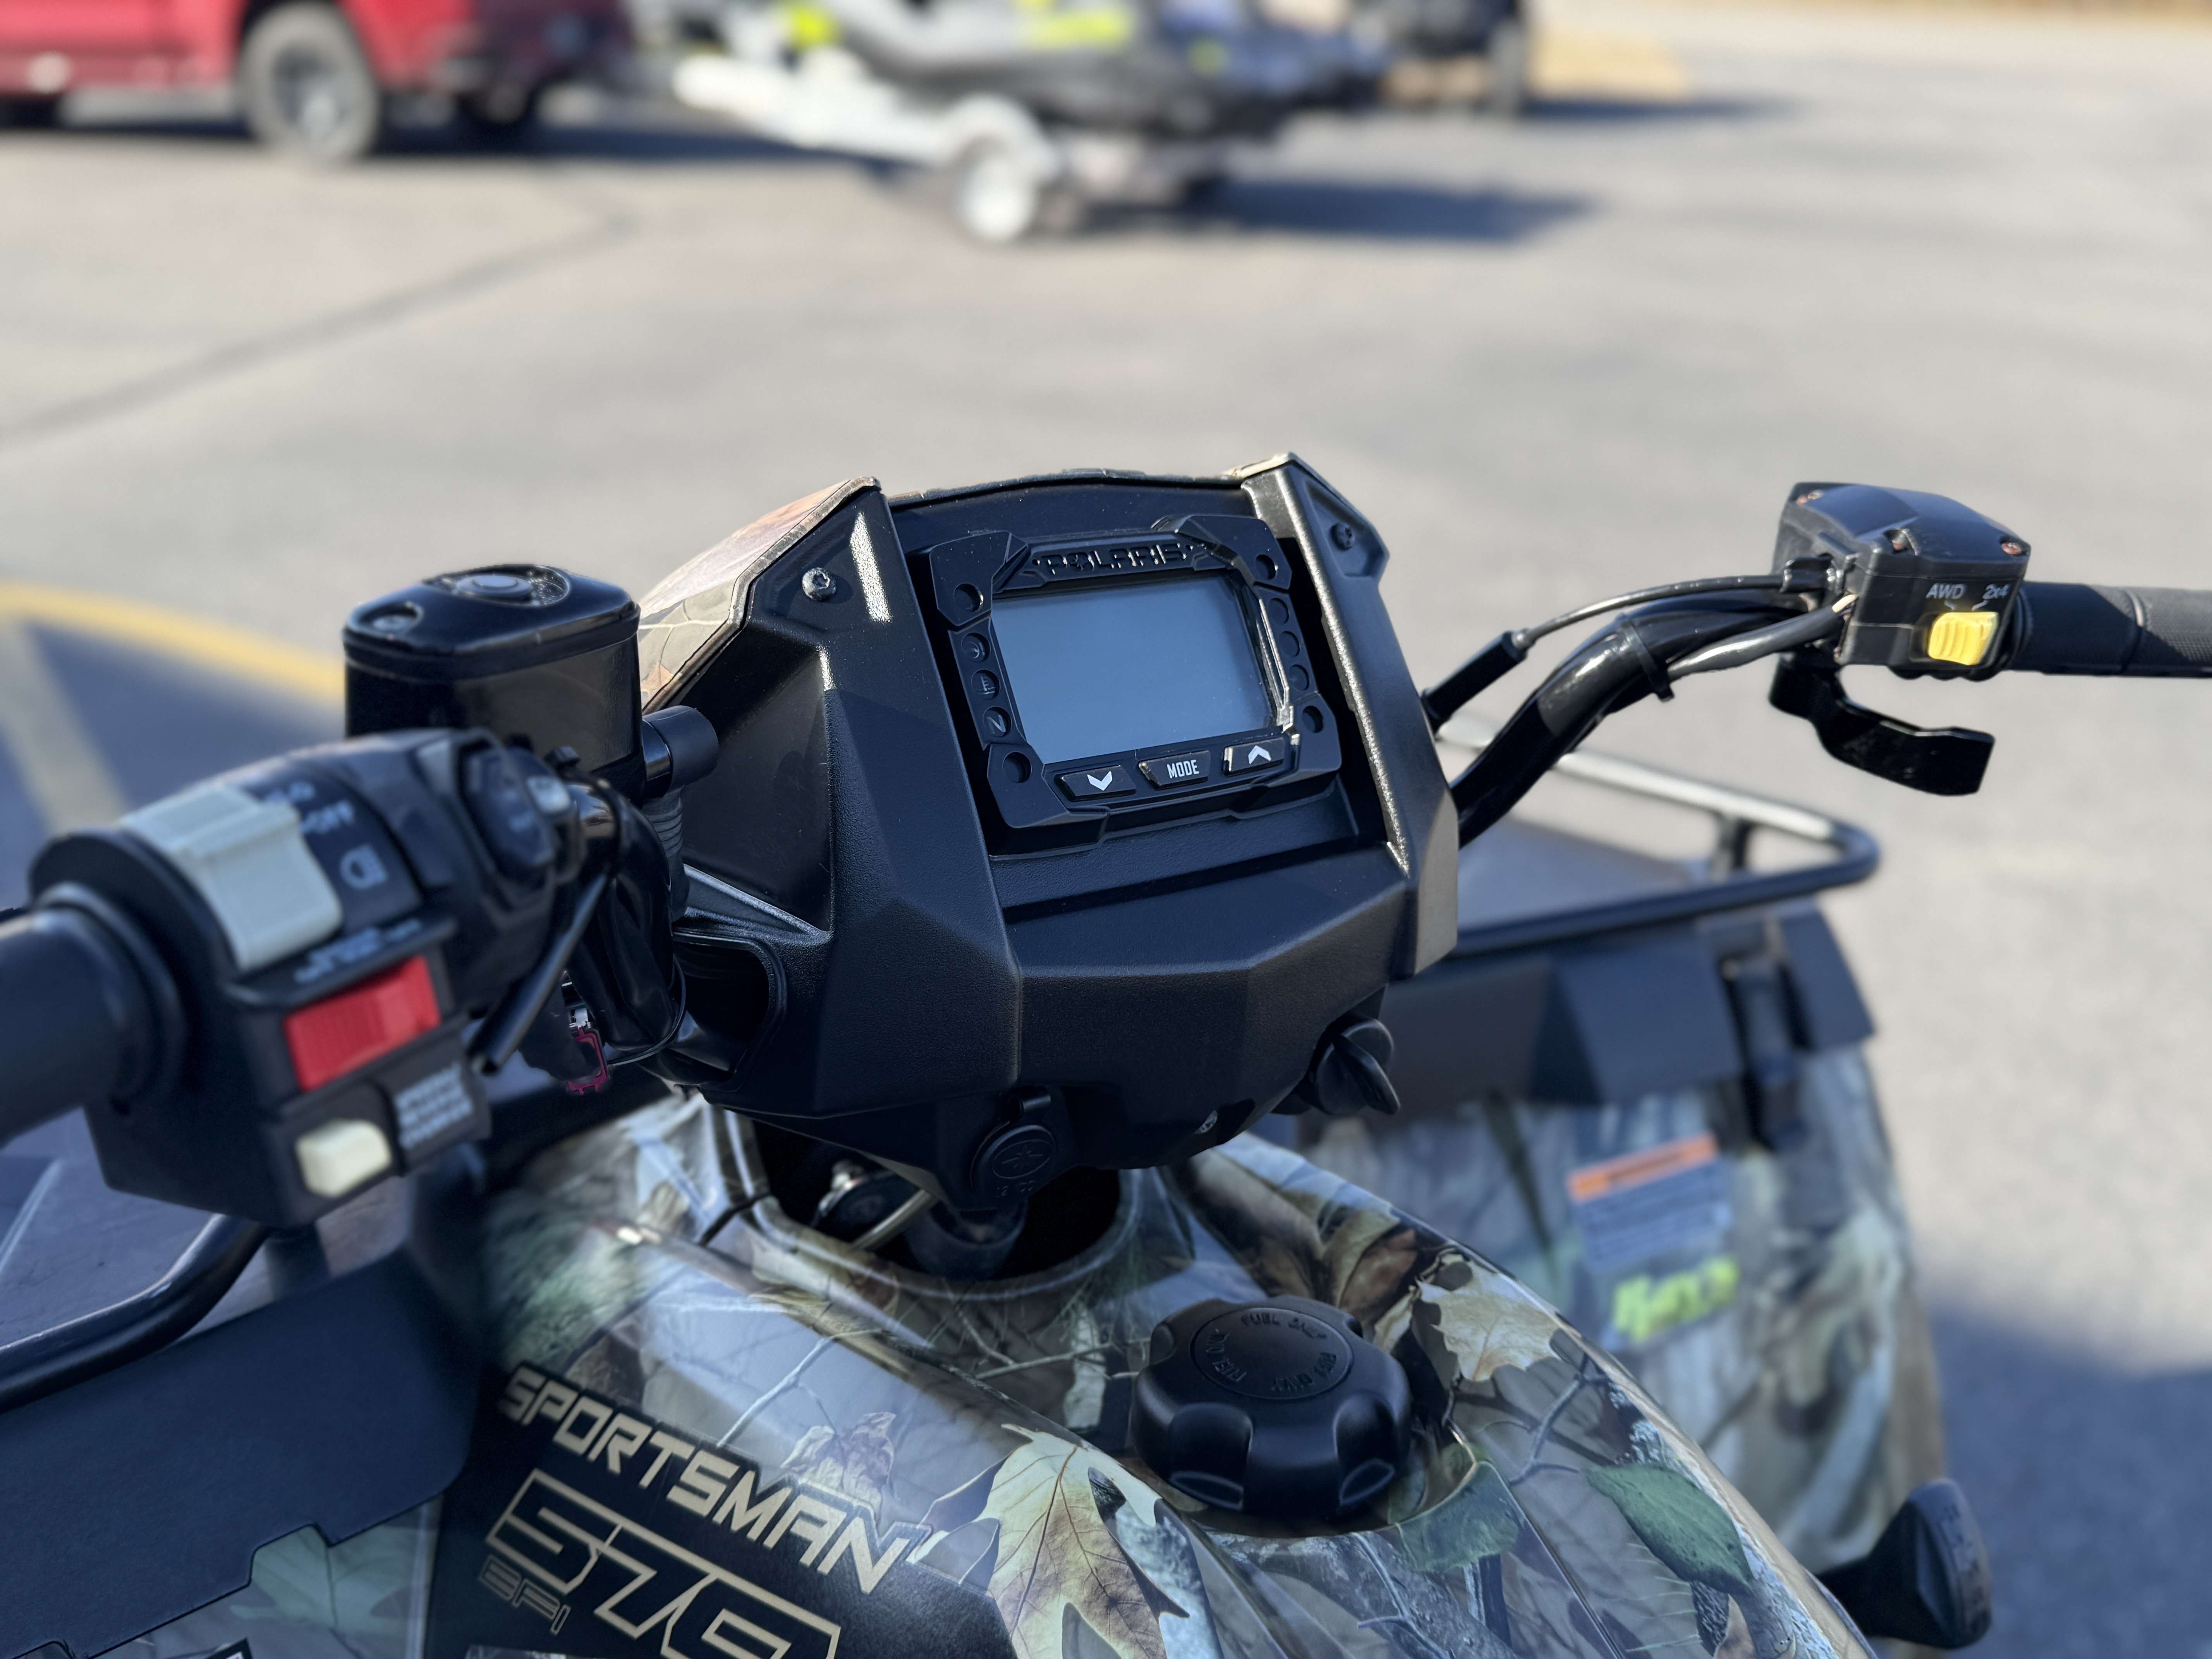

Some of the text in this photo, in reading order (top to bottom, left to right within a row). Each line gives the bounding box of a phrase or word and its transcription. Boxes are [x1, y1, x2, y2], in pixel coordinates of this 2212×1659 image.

[1042, 543, 1187, 575] POLARIS
[1926, 583, 2010, 599] AWD 2x4
[1167, 759, 1199, 779] MODE
[501, 1369, 910, 1595] SPORTSMAN
